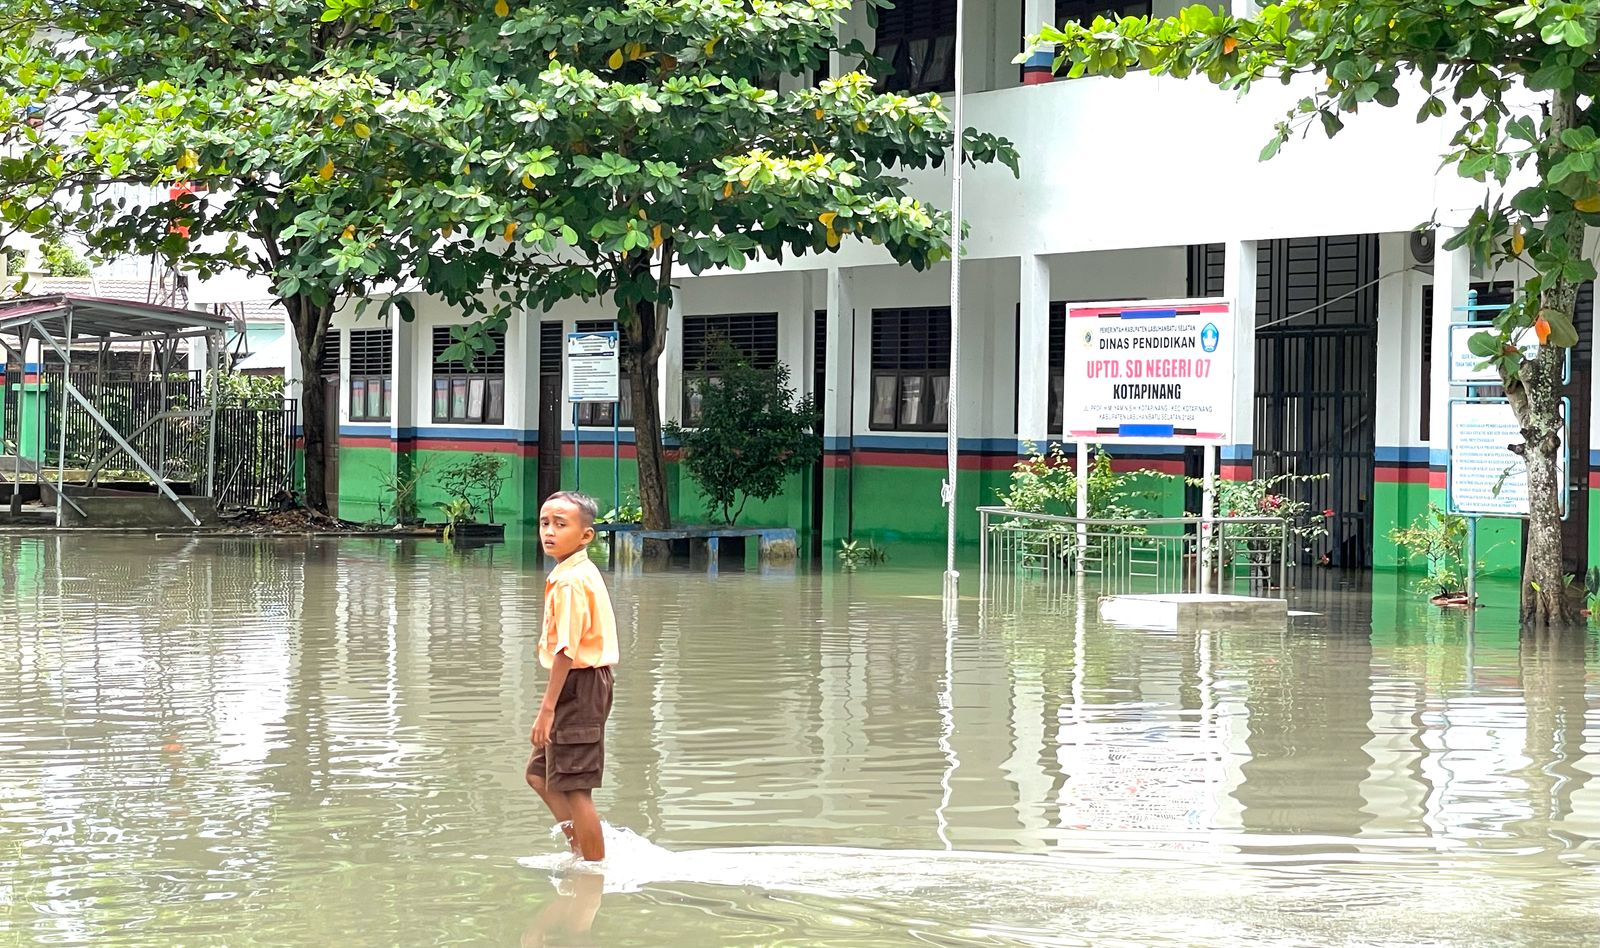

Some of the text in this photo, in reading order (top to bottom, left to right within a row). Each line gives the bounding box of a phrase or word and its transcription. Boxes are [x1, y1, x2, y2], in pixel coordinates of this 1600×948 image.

[1099, 336, 1196, 350] DINAS PENDIDIKAN
[1087, 359, 1211, 378] UPTD. SD NEGERI 07
[1113, 384, 1181, 399] KOTAPINANG
